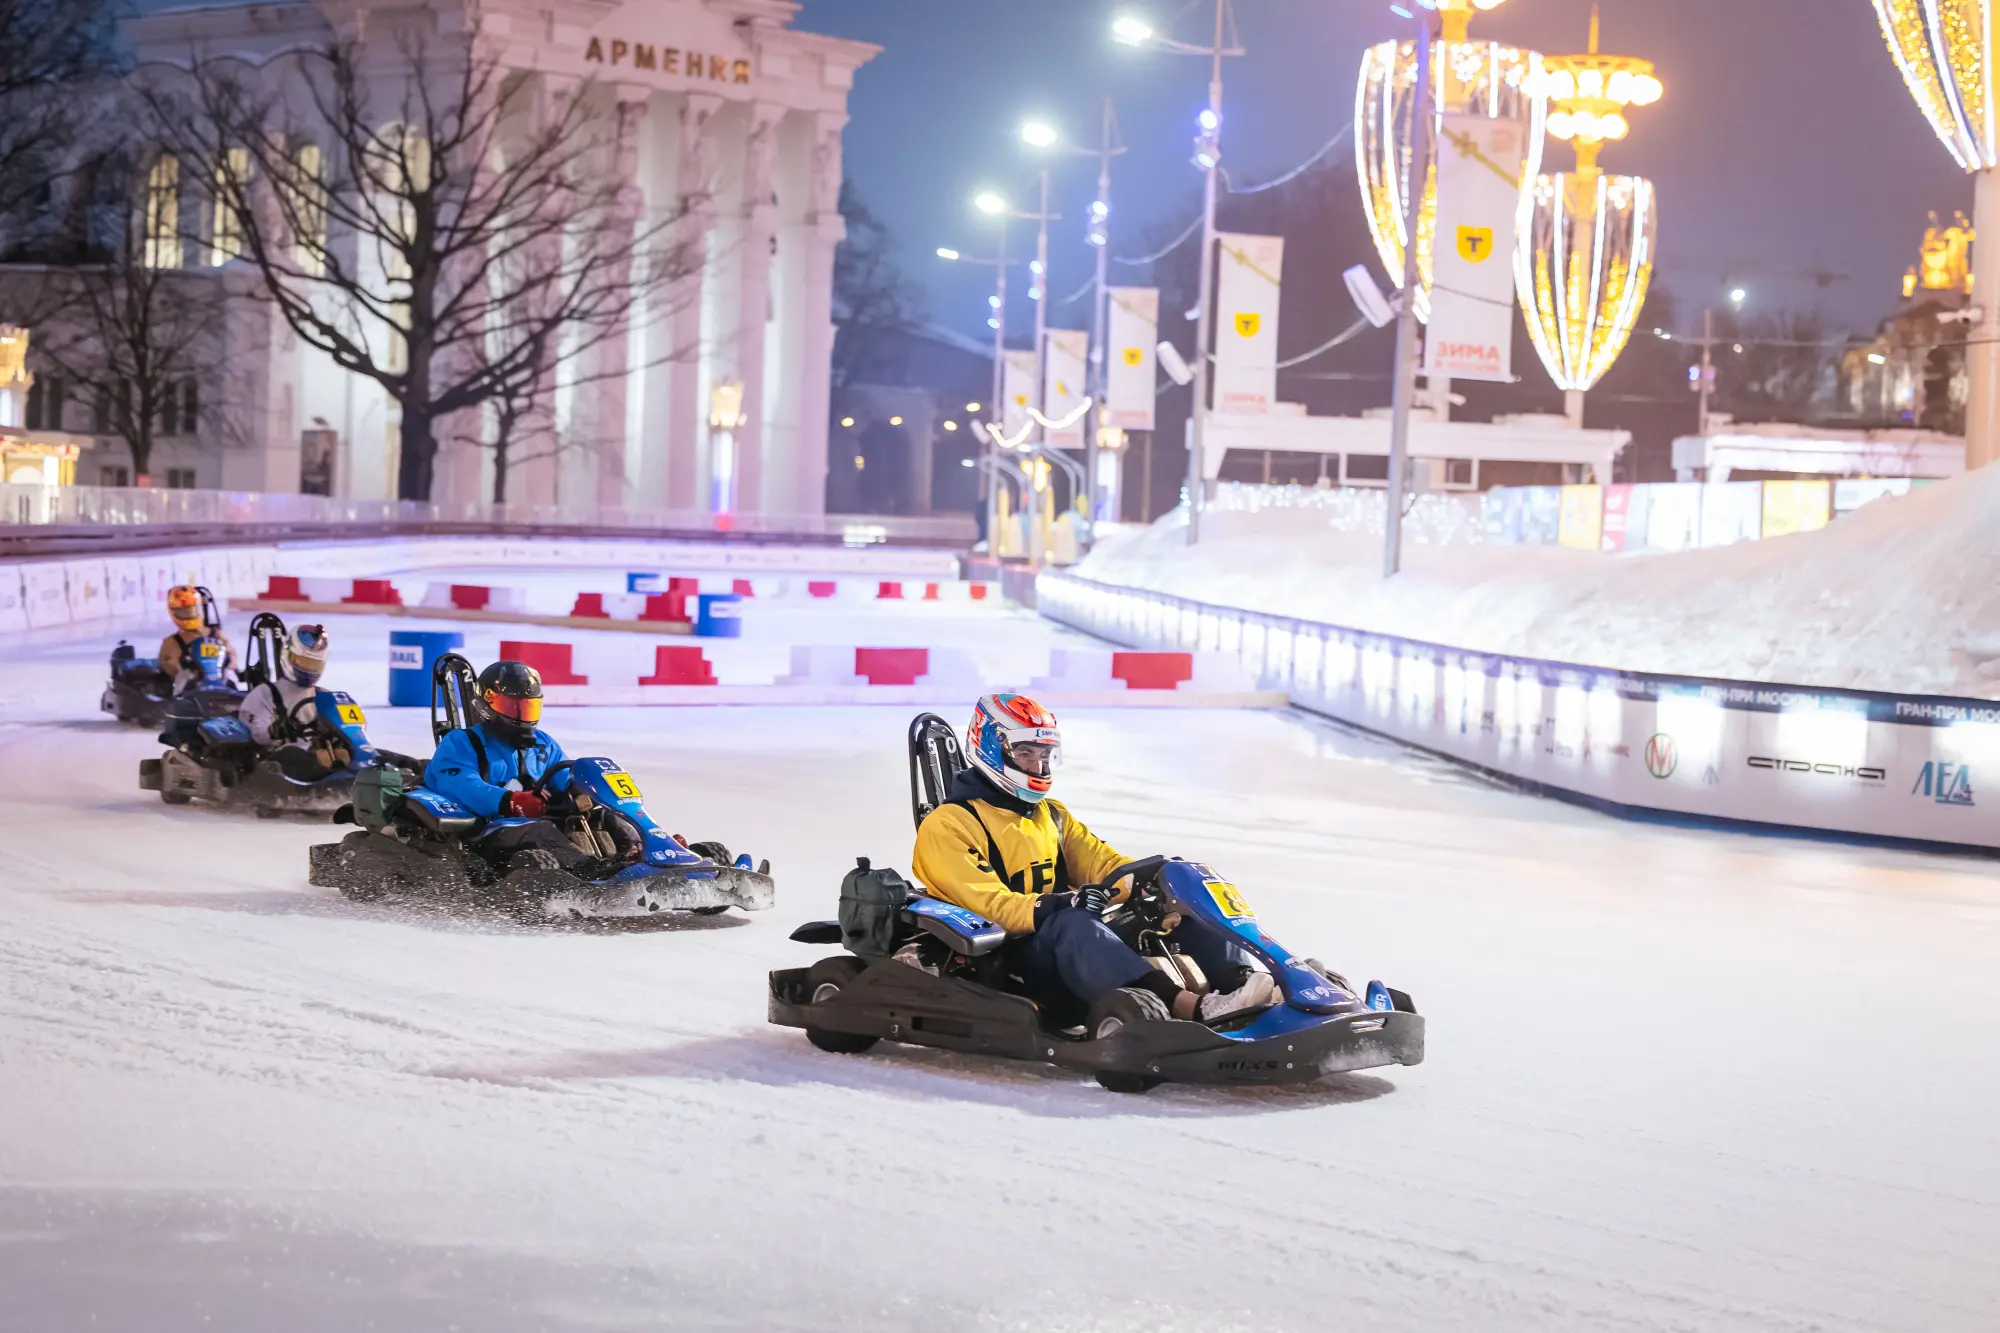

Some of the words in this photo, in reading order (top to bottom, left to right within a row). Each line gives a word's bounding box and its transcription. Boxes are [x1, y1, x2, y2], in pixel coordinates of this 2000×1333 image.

[585, 36, 749, 84] АРМЕНИЯ
[348, 708, 358, 721] 4
[1896, 702, 1965, 720] ГРАН-ПРИ
[616, 779, 633, 796] 5
